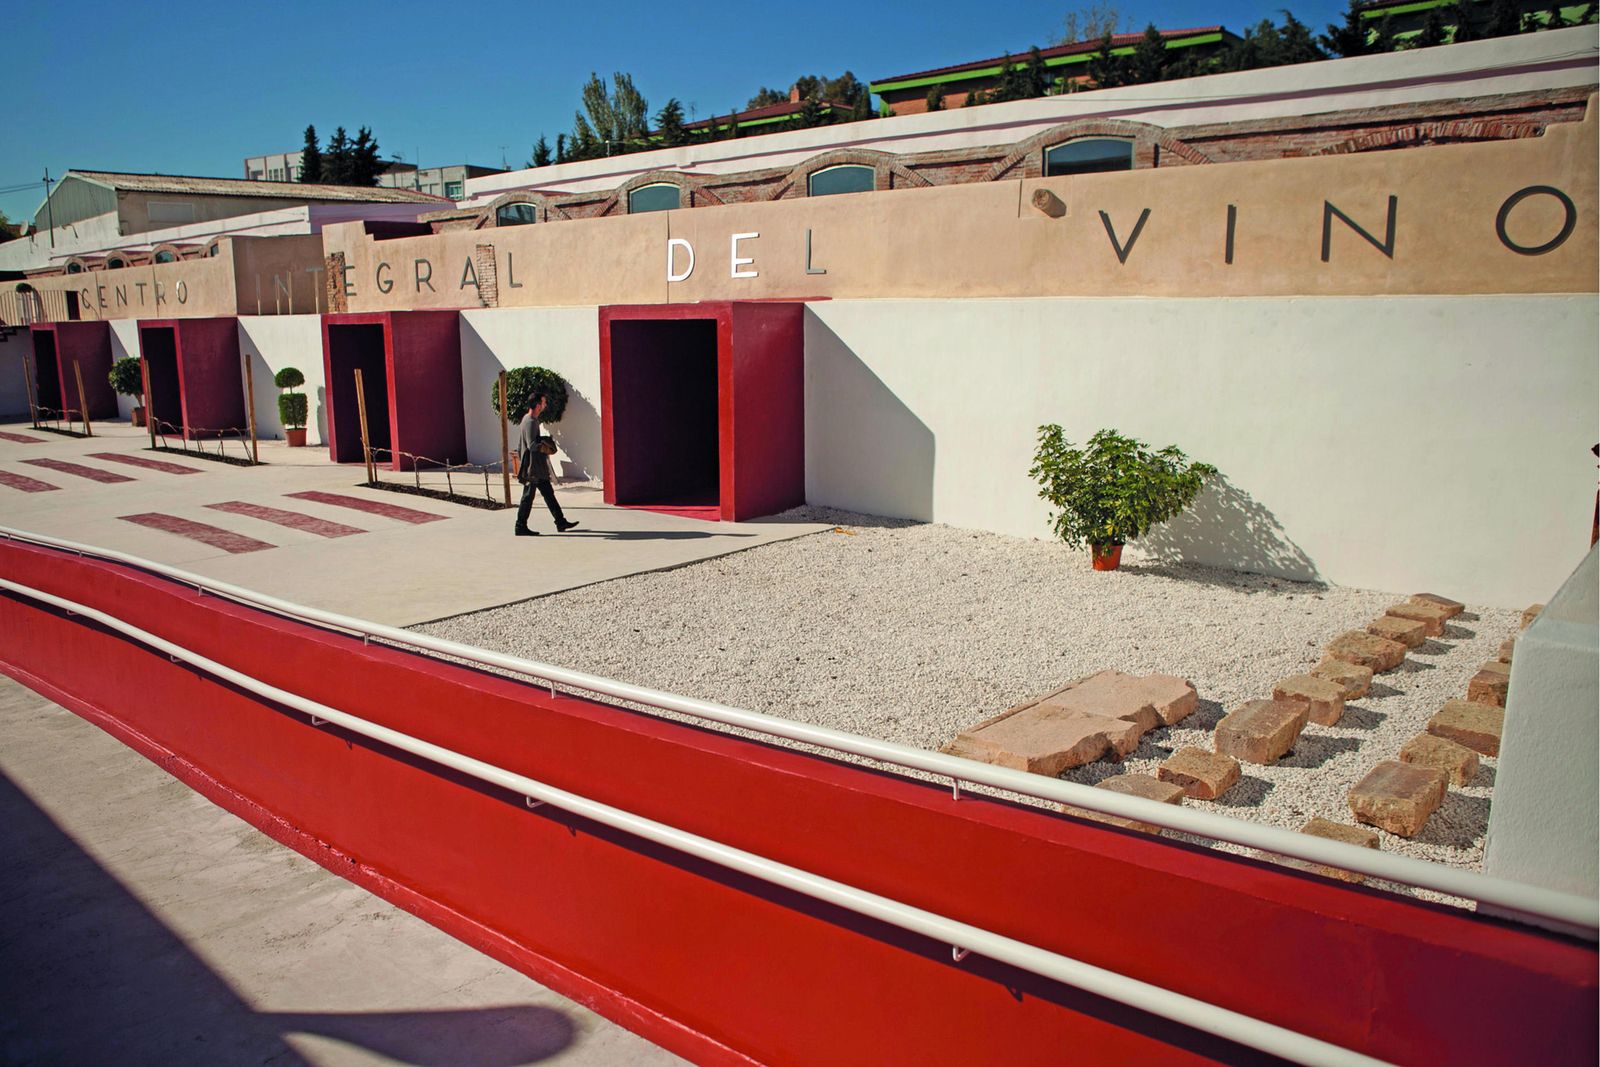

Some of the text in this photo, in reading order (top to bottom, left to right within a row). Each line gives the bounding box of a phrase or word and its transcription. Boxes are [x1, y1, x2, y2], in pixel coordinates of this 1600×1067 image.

[80, 184, 1577, 310] CENTRO INTEGRAL DEL VINO
